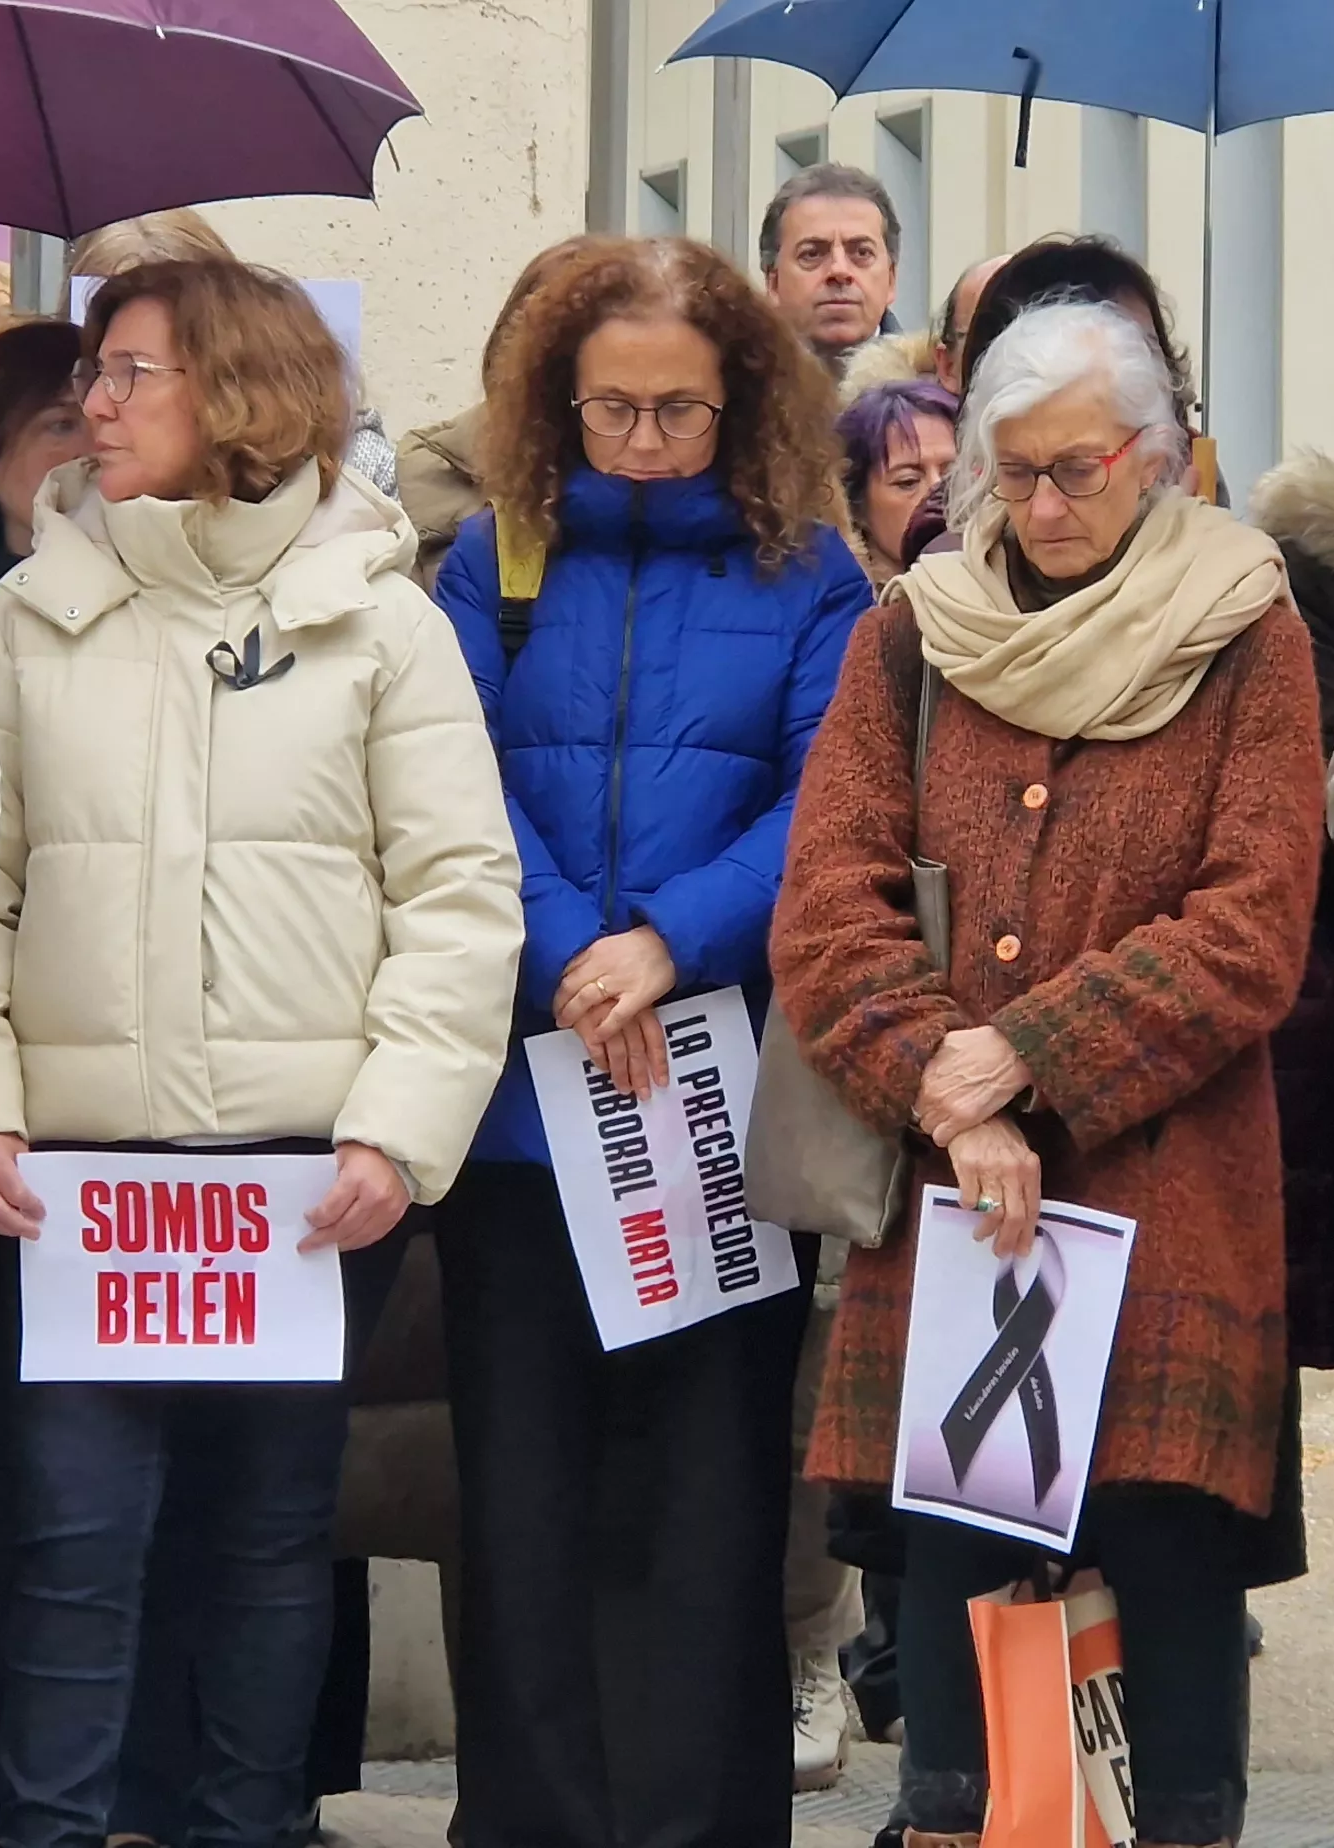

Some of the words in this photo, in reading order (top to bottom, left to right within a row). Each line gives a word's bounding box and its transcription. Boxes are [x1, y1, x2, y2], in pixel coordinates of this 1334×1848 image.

[664, 1014, 713, 1060] LA
[80, 1180, 270, 1253] SOMOS
[677, 1066, 761, 1294] PRECARIEDAD
[96, 1257, 256, 1345] BELÉN
[620, 1208, 680, 1307] MATA
